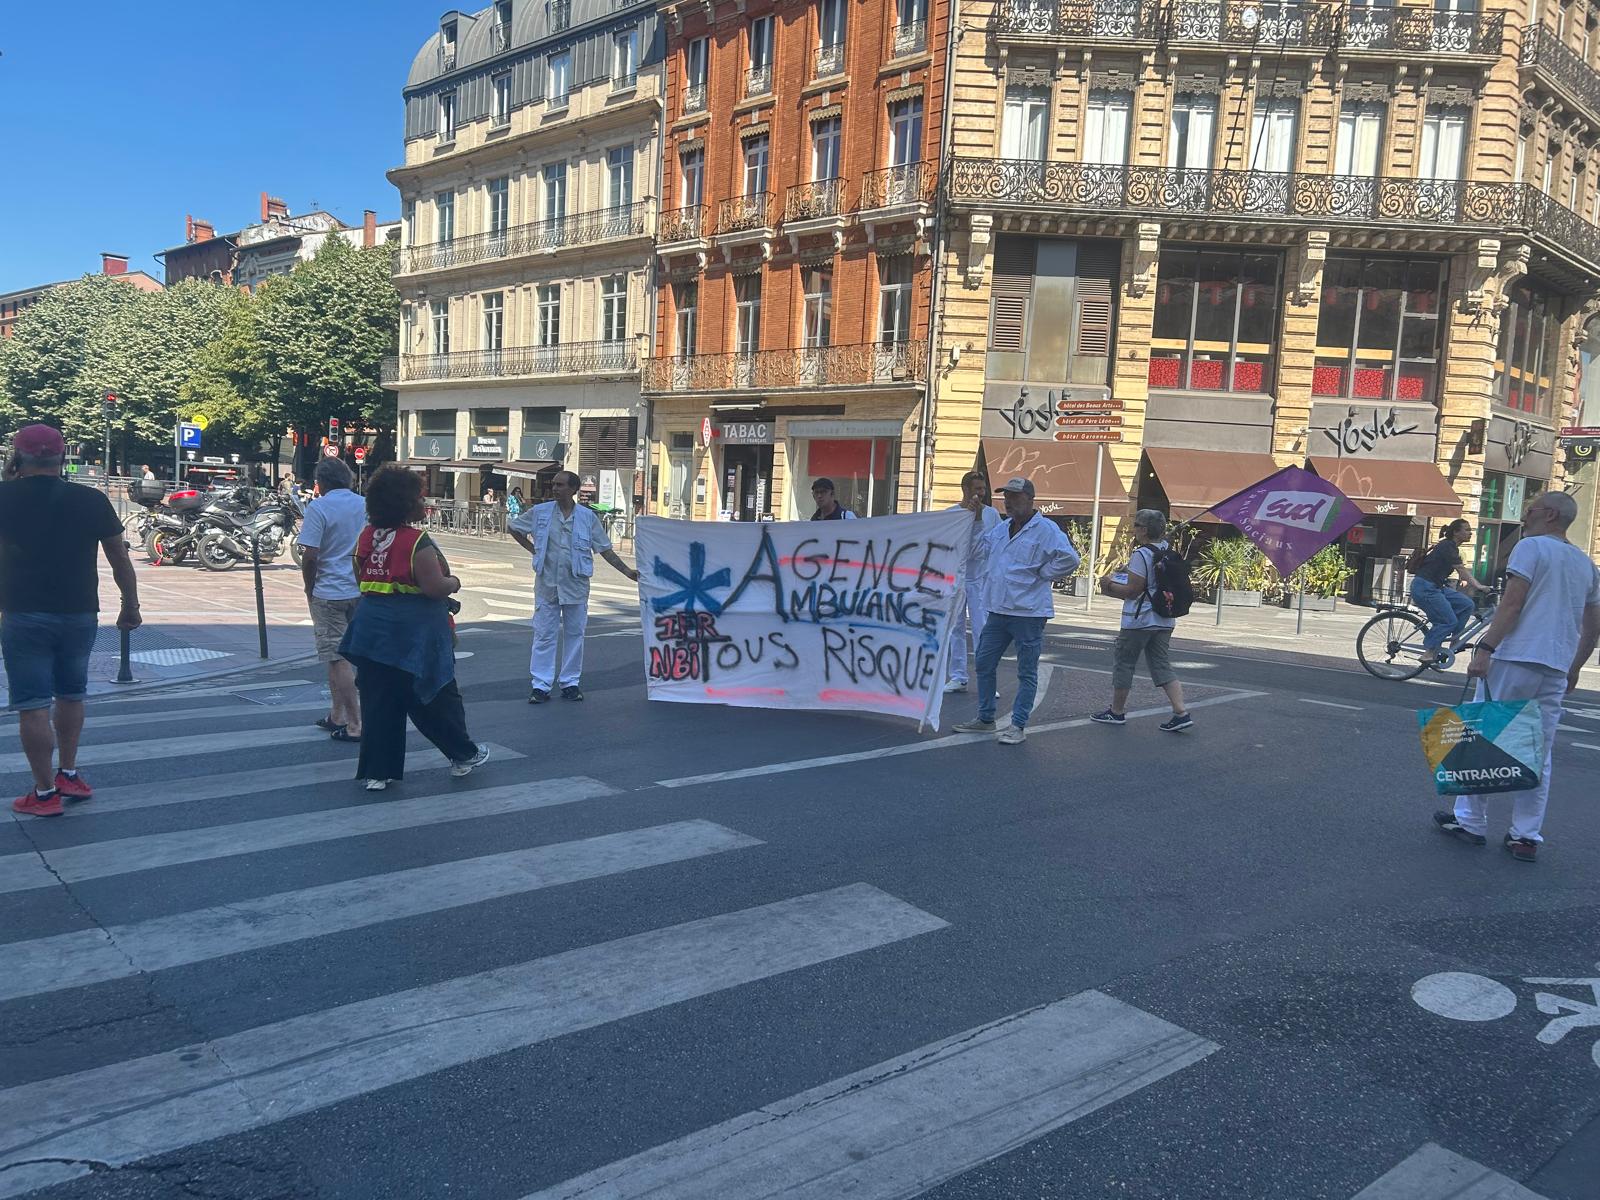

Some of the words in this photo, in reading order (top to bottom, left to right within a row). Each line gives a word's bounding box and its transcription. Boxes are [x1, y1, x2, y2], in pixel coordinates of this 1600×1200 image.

[183, 428, 195, 442] P
[723, 424, 766, 438] TABAC
[721, 525, 953, 623] AGENCE
[677, 632, 799, 683] TOUS
[1436, 766, 1522, 782] CENTRAKOR
